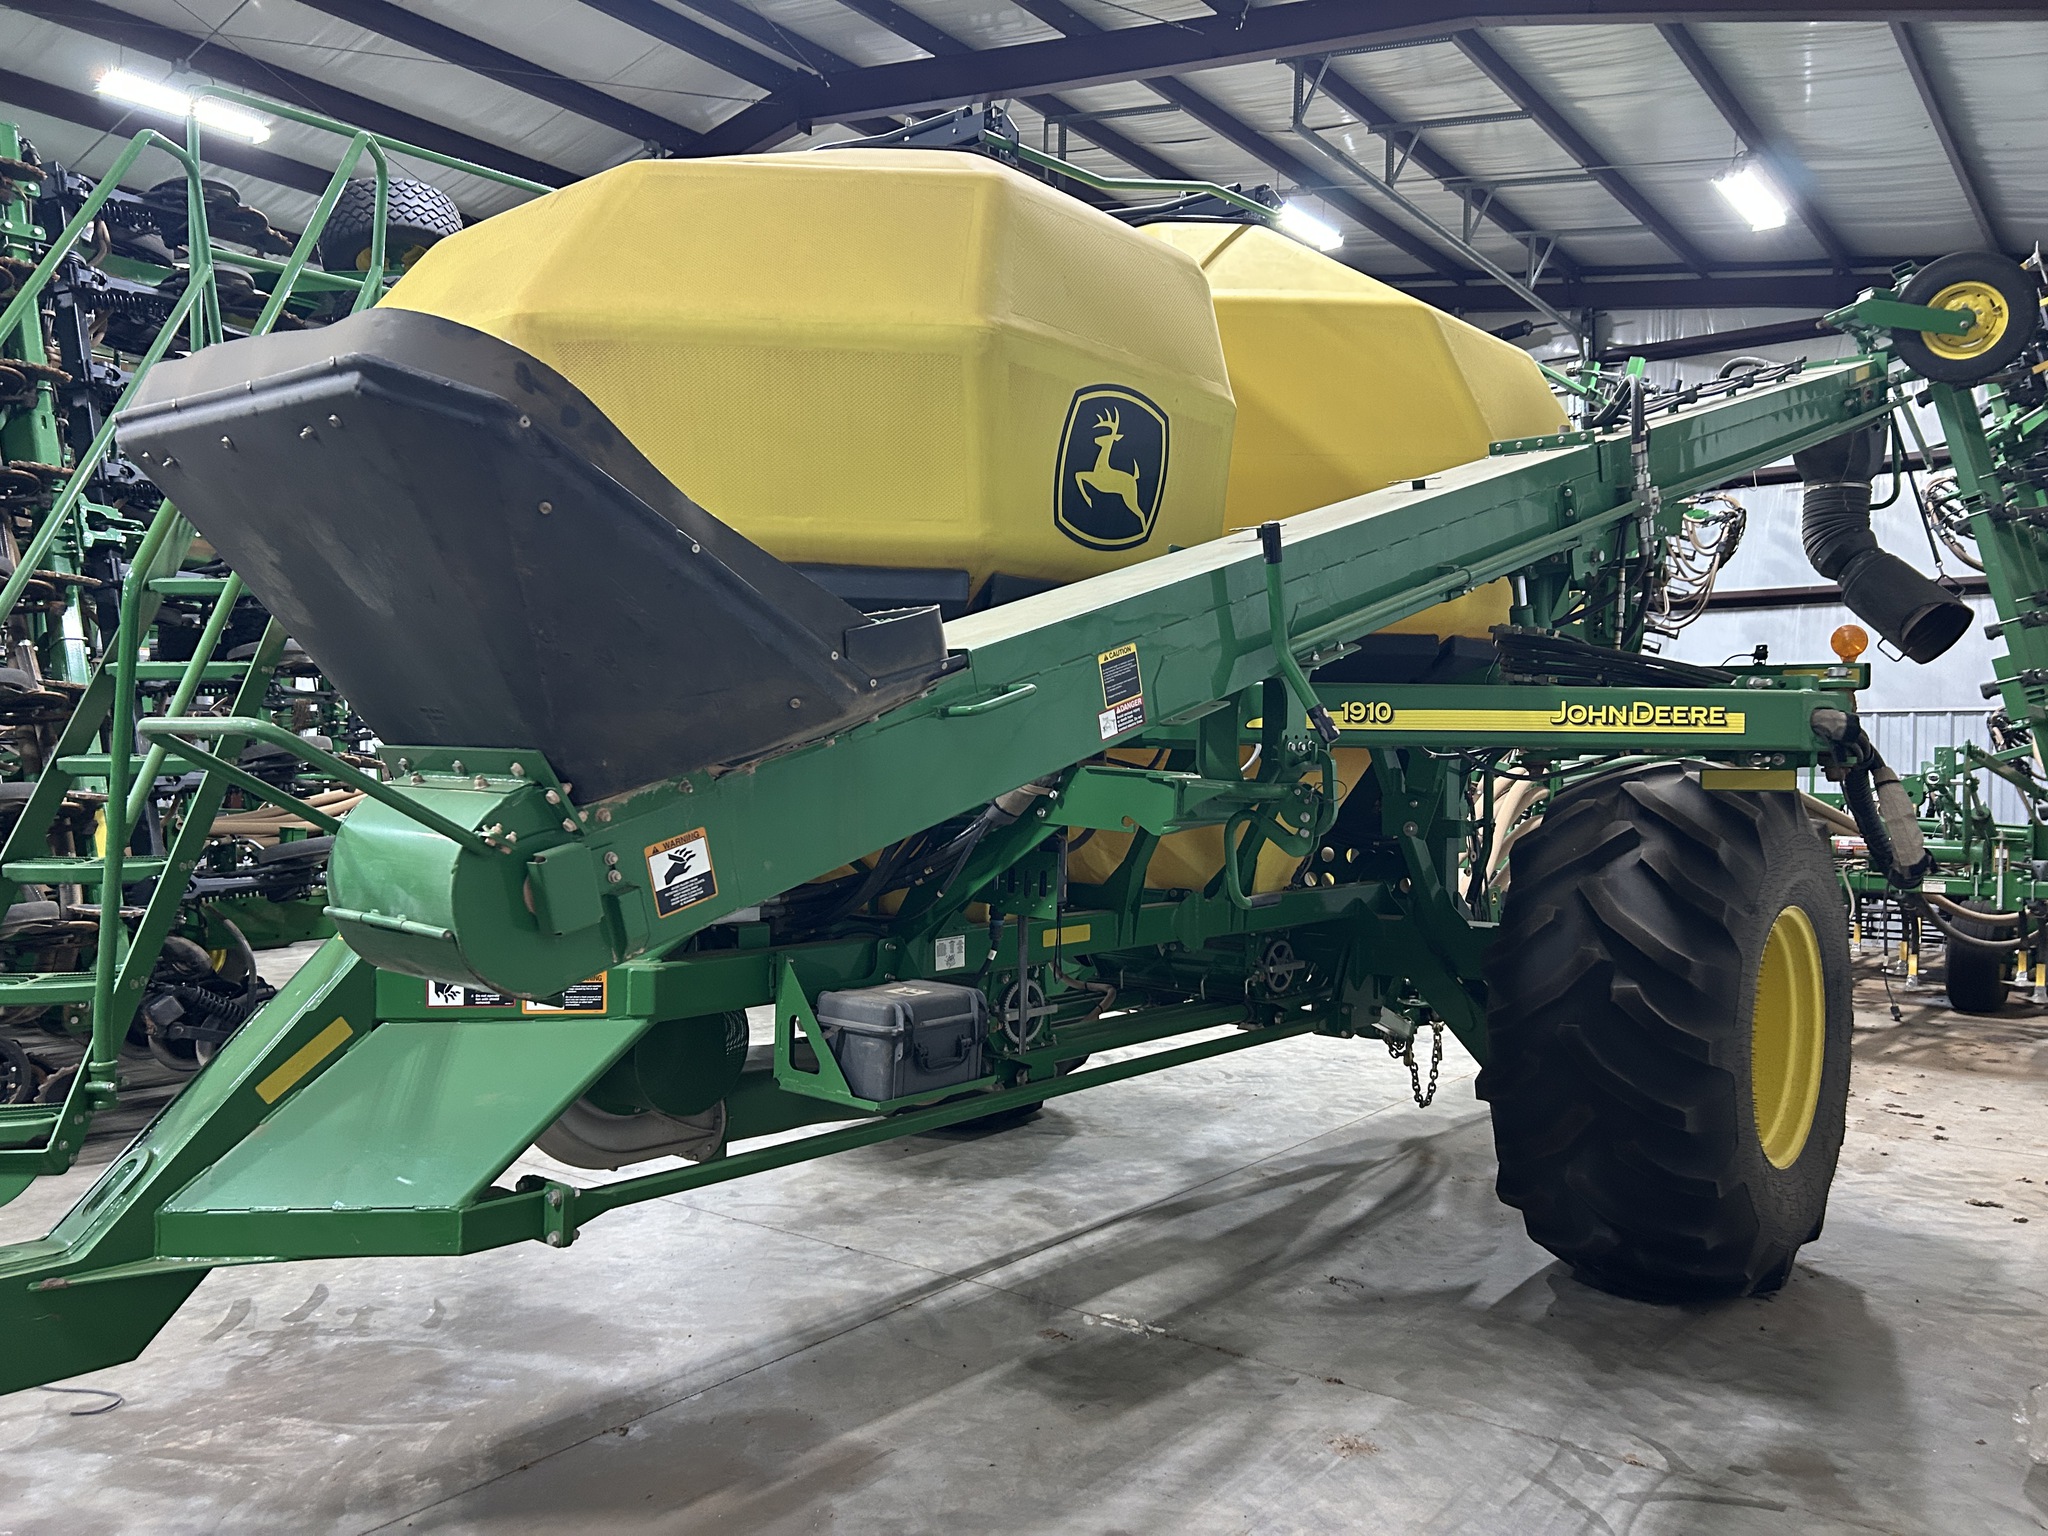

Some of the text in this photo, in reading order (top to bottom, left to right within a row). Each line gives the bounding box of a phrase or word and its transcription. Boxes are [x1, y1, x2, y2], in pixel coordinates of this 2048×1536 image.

[1108, 646, 1131, 658] CAUTION
[1119, 697, 1142, 711] DANGER
[1341, 701, 1393, 722] 1910
[1550, 700, 1727, 725] JOHN DEERE
[662, 831, 700, 850] WARNING
